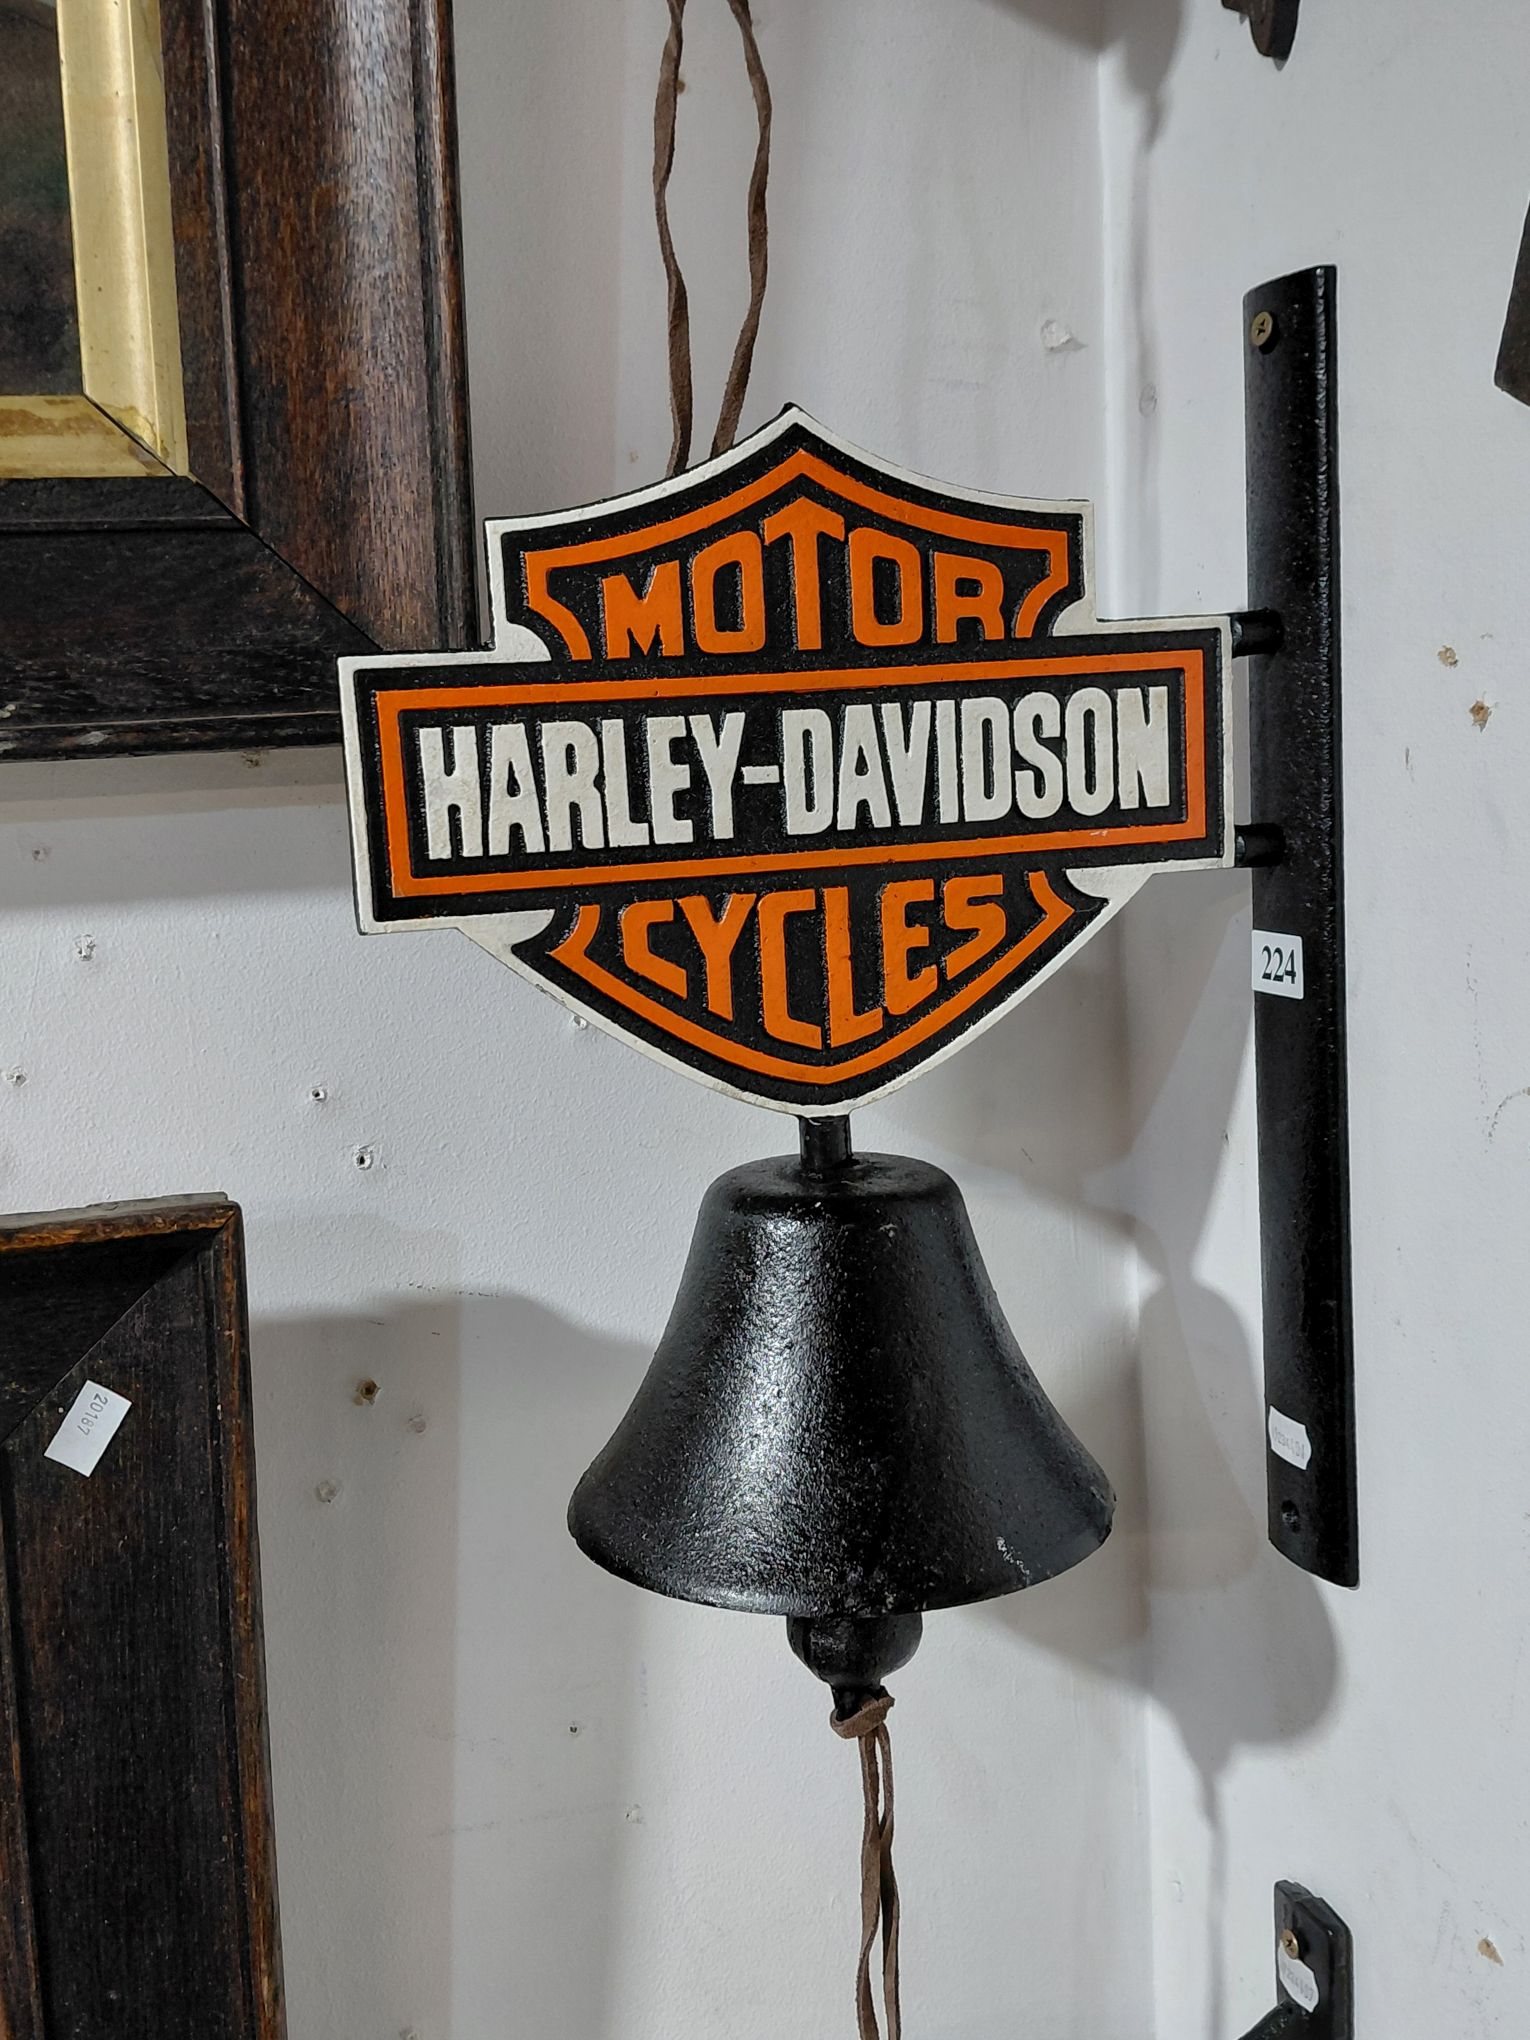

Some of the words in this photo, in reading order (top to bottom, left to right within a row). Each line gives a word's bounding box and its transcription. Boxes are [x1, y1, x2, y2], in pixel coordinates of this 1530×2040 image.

[601, 497, 1004, 658] MOTOR
[418, 684, 1172, 861] HARLEY-DAVIDSON
[621, 872, 1005, 1050] CYCLES
[1261, 945, 1297, 985] 224
[77, 1392, 108, 1436] 20187
